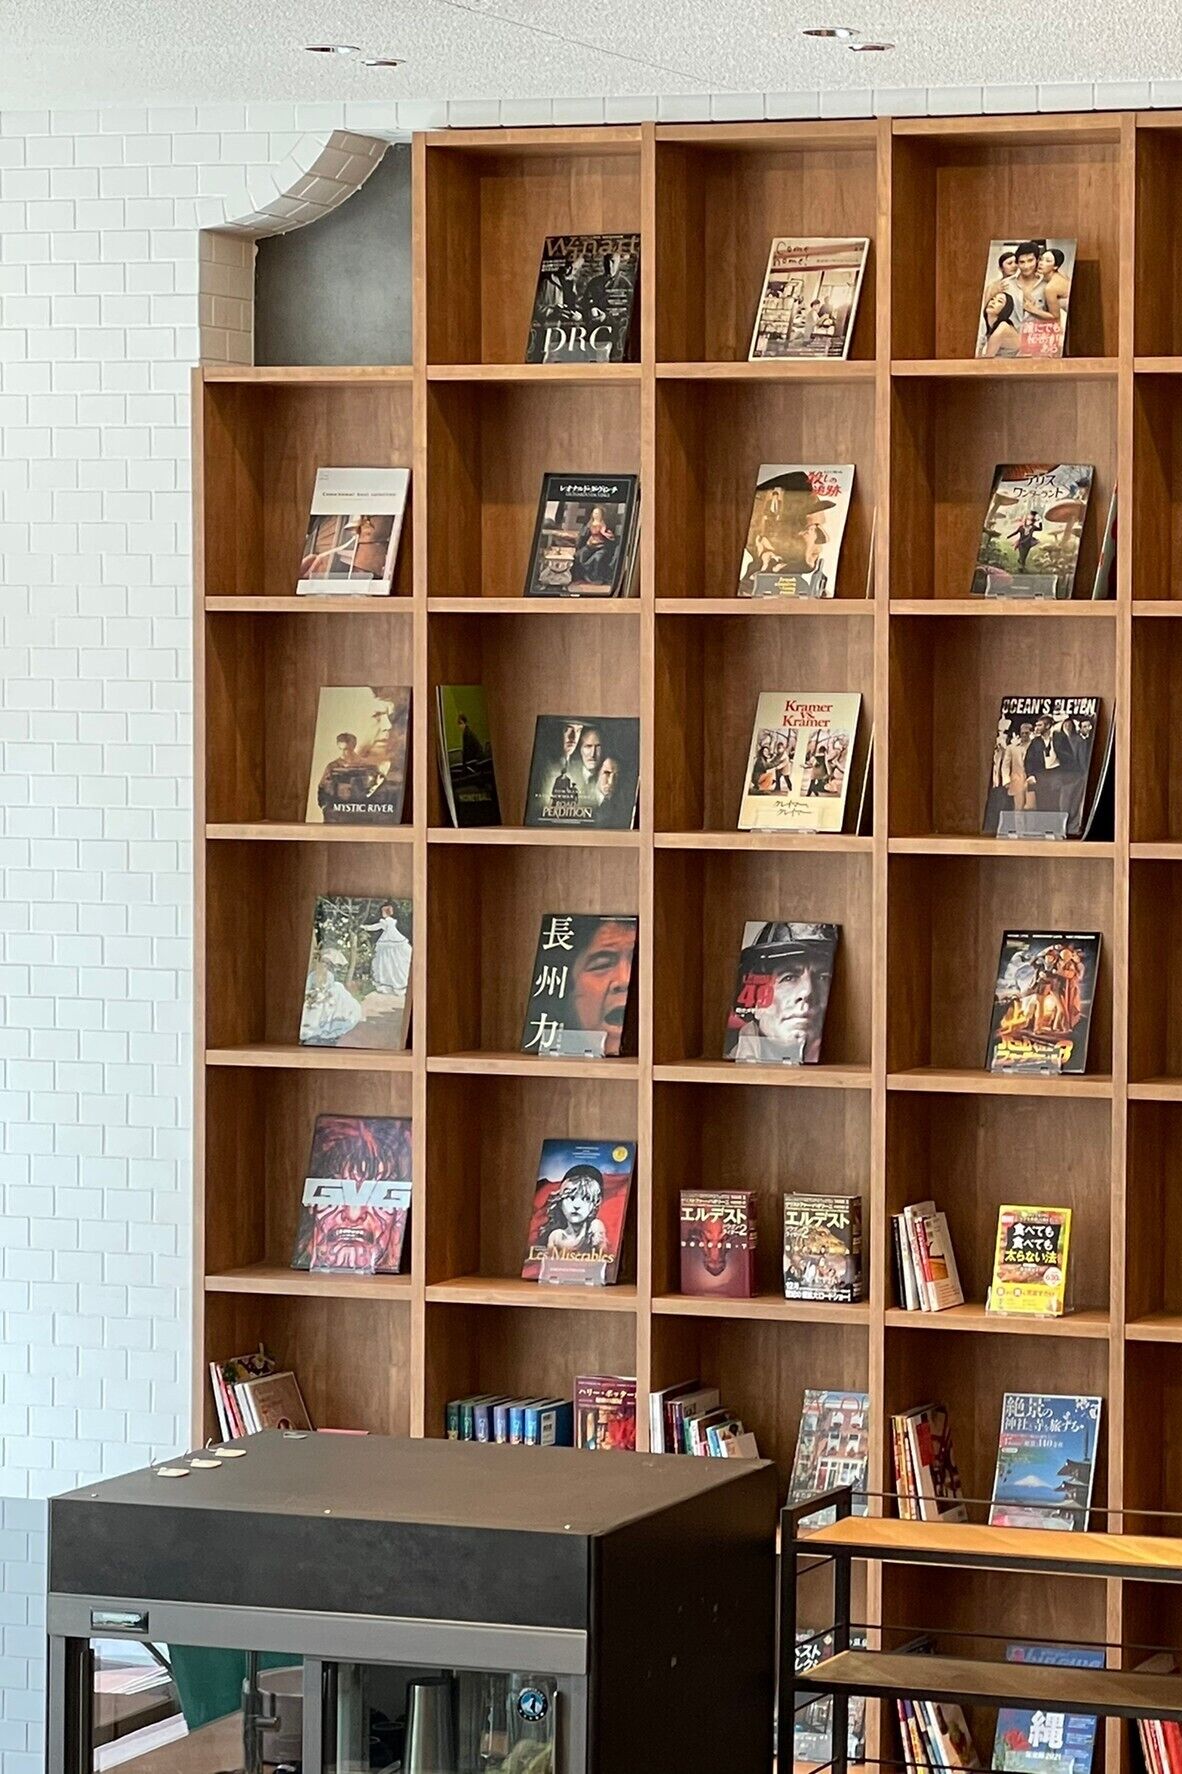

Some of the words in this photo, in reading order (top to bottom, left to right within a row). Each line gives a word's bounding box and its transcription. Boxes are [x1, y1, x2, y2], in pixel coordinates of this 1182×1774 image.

[544, 326, 612, 352] DRC
[785, 700, 833, 712] Kramer
[1002, 698, 1051, 714] OCEAN'S
[1052, 698, 1096, 715] ELEVEN
[782, 715, 831, 727] Kramer
[333, 803, 366, 812] MYSTIC
[367, 803, 394, 813] RIVER
[524, 917, 575, 1049] 長州力
[302, 1178, 412, 1207] GVG
[680, 1207, 747, 1224] エルデスト
[785, 1211, 850, 1229] エルデスト
[1013, 1223, 1055, 1238] 食べても
[1012, 1236, 1054, 1251] 食べても
[1005, 1250, 1058, 1264] 太らない法
